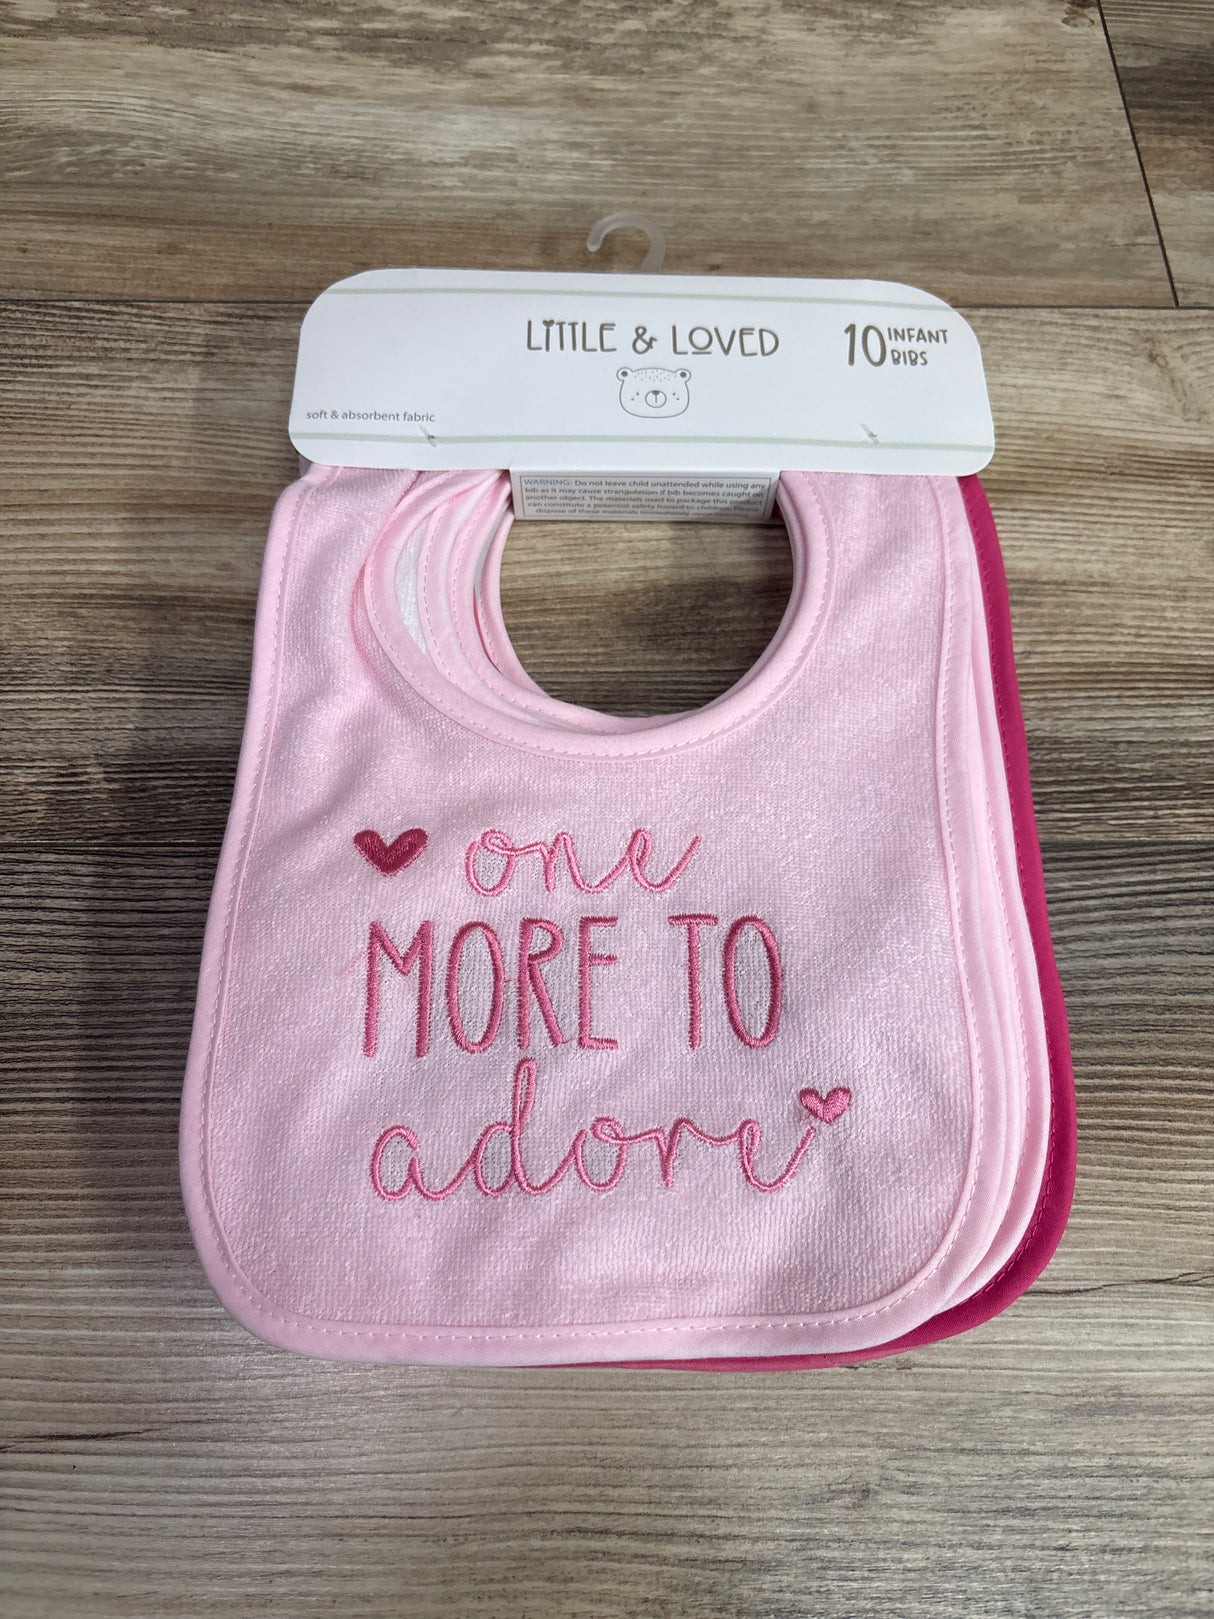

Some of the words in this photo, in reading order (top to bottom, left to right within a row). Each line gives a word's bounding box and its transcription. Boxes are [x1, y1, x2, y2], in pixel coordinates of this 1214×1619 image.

[527, 320, 618, 352] LITTLE
[632, 326, 658, 355] &
[672, 325, 779, 357] LOVED
[843, 323, 887, 367] 10
[887, 326, 948, 344] INFANT
[890, 348, 928, 366] BIBS
[306, 409, 327, 420] soft
[330, 410, 339, 420] &
[341, 410, 400, 421] absorbent
[402, 411, 435, 422] fabric
[628, 480, 649, 488] child
[701, 481, 724, 489] while
[726, 482, 749, 490] using
[464, 828, 700, 897] one
[362, 915, 620, 1058] MORE
[667, 914, 784, 1050] TO
[369, 1056, 817, 1201] adore
